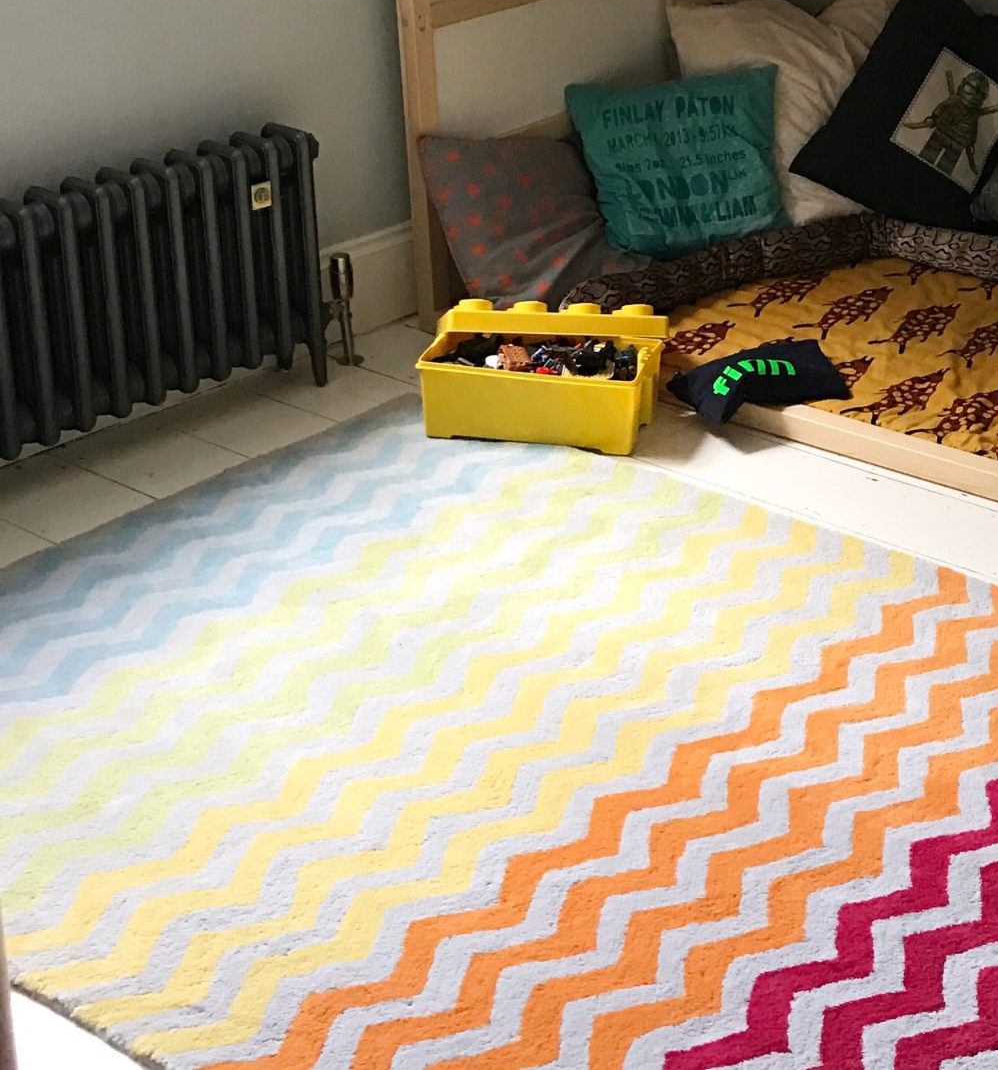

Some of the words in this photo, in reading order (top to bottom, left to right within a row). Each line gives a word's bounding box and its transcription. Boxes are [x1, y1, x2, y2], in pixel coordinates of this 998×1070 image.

[602, 100, 664, 129] FINLAY
[675, 95, 735, 119] PATON
[607, 131, 653, 153] MARCH
[663, 128, 690, 147] 2013
[679, 153, 703, 169] 21.5
[705, 149, 747, 166] inches
[624, 170, 729, 203] LONDON
[715, 195, 757, 222] LIAM
